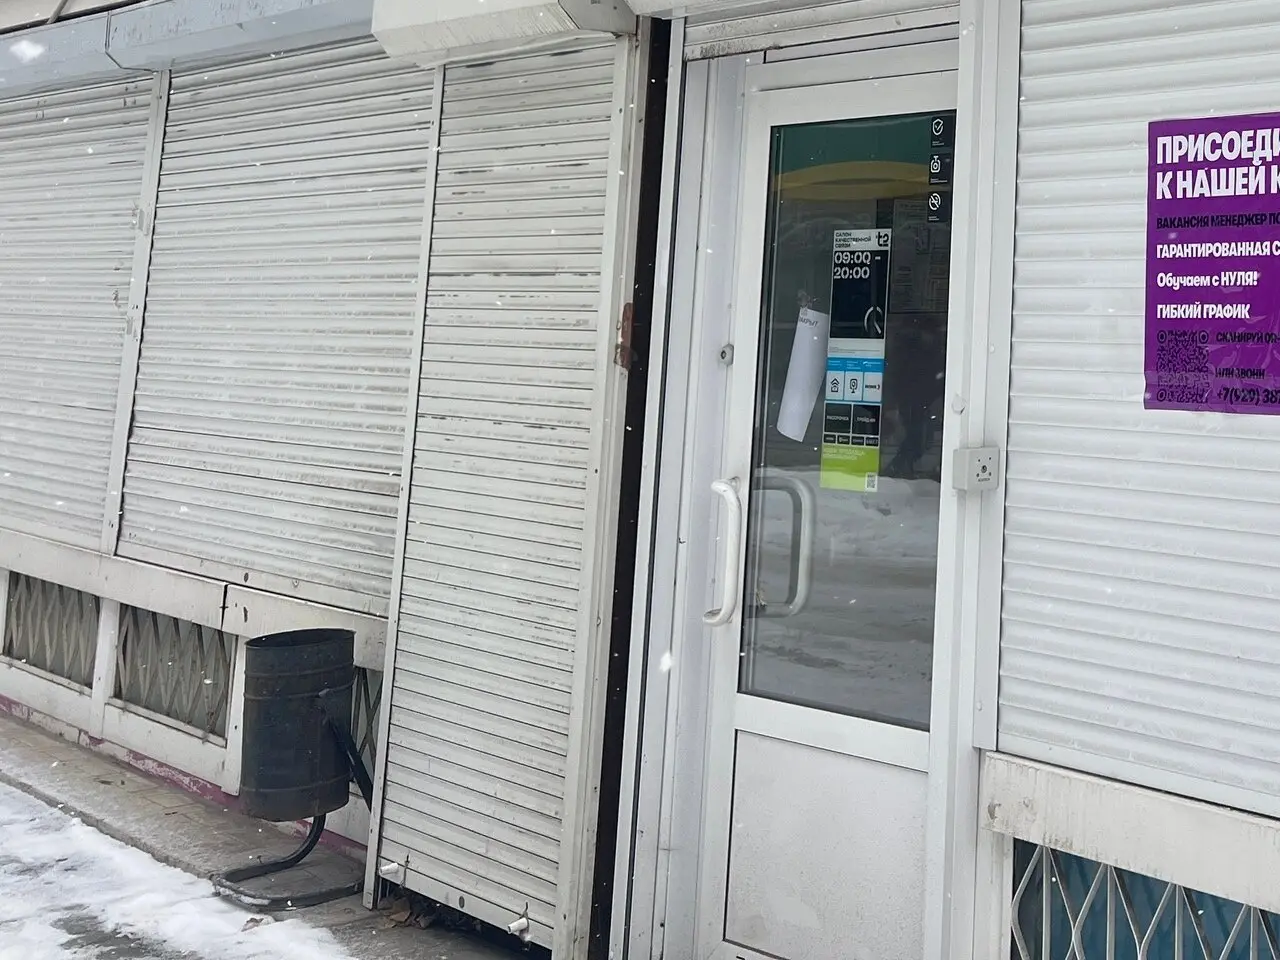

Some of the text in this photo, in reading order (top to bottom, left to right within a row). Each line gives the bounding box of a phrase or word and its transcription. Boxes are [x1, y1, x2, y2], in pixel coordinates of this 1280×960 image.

[1156, 170, 1174, 199] К
[1176, 160, 1266, 198] НАШЕЙ
[1156, 214, 1209, 229] ВАКАНСИЯ
[1211, 212, 1268, 228] МЕНЕДЖЕР
[834, 251, 871, 264] 09:00
[1156, 241, 1270, 259] ГАРАНТИРОВАННАЯ
[833, 266, 870, 279] 20:00
[1156, 271, 1258, 290] Обучаем с НУЛЯ!
[1156, 301, 1250, 319] ГИБКИЙ ГРАФИК
